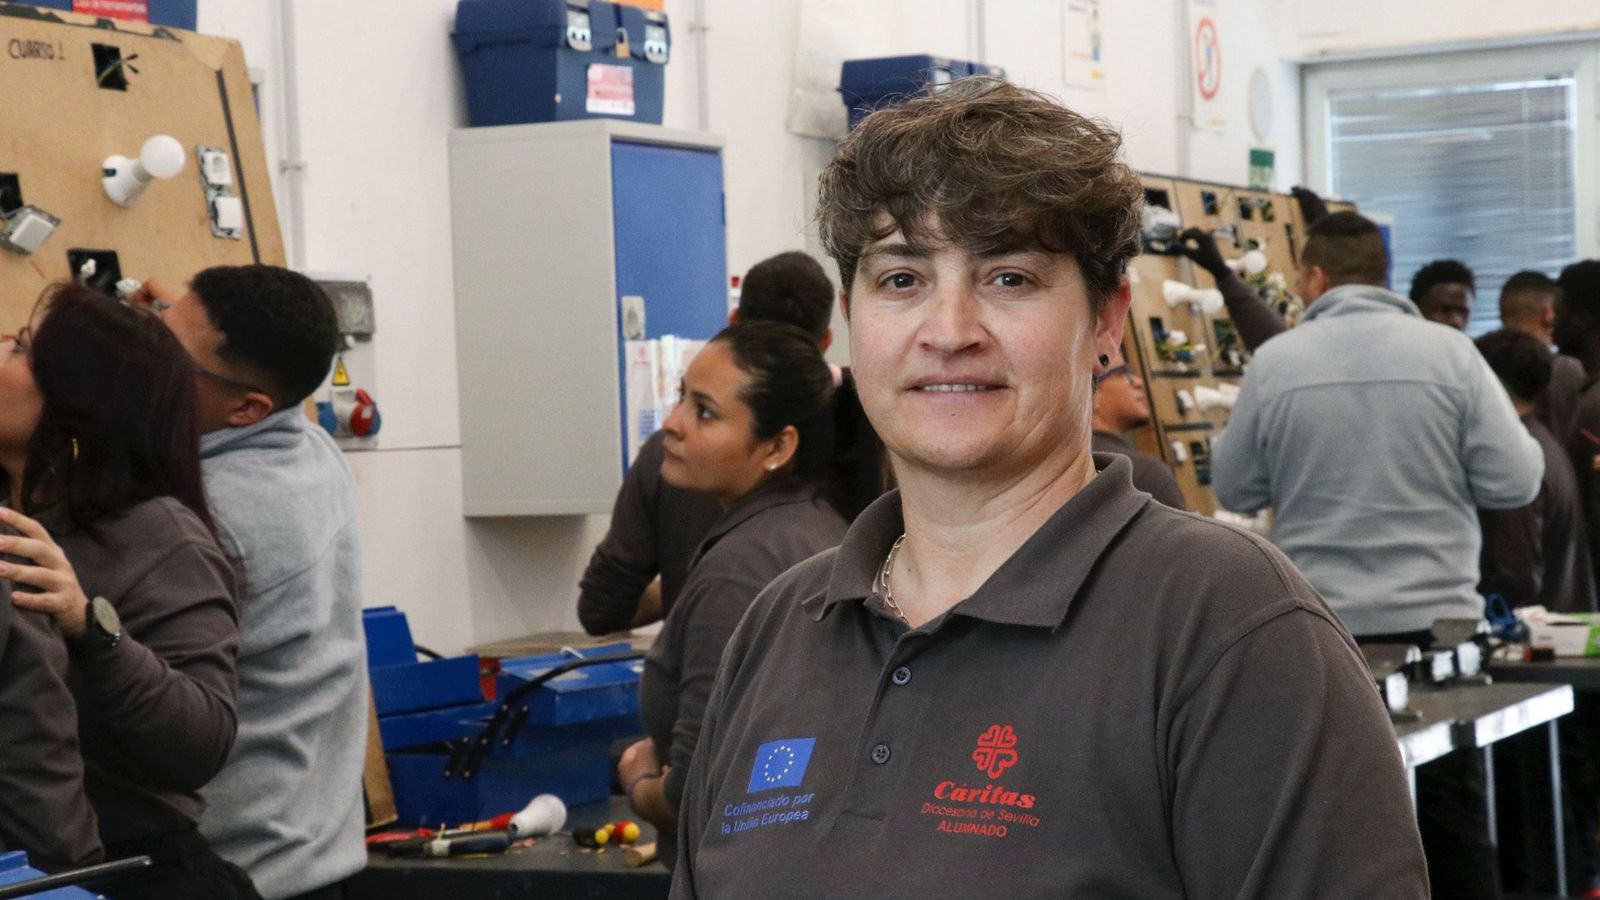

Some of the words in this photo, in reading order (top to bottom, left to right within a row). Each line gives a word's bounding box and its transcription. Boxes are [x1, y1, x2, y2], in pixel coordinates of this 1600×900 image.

[724, 794, 790, 817] Cofinanciado
[791, 792, 816, 808] por
[934, 780, 1036, 808] Cáritas
[721, 822, 731, 835] la
[761, 810, 810, 825] Europea
[921, 802, 978, 818] Diocesana
[980, 808, 995, 820] de
[998, 809, 1041, 827] Sevilla
[937, 820, 1008, 837] ALUMNADO
